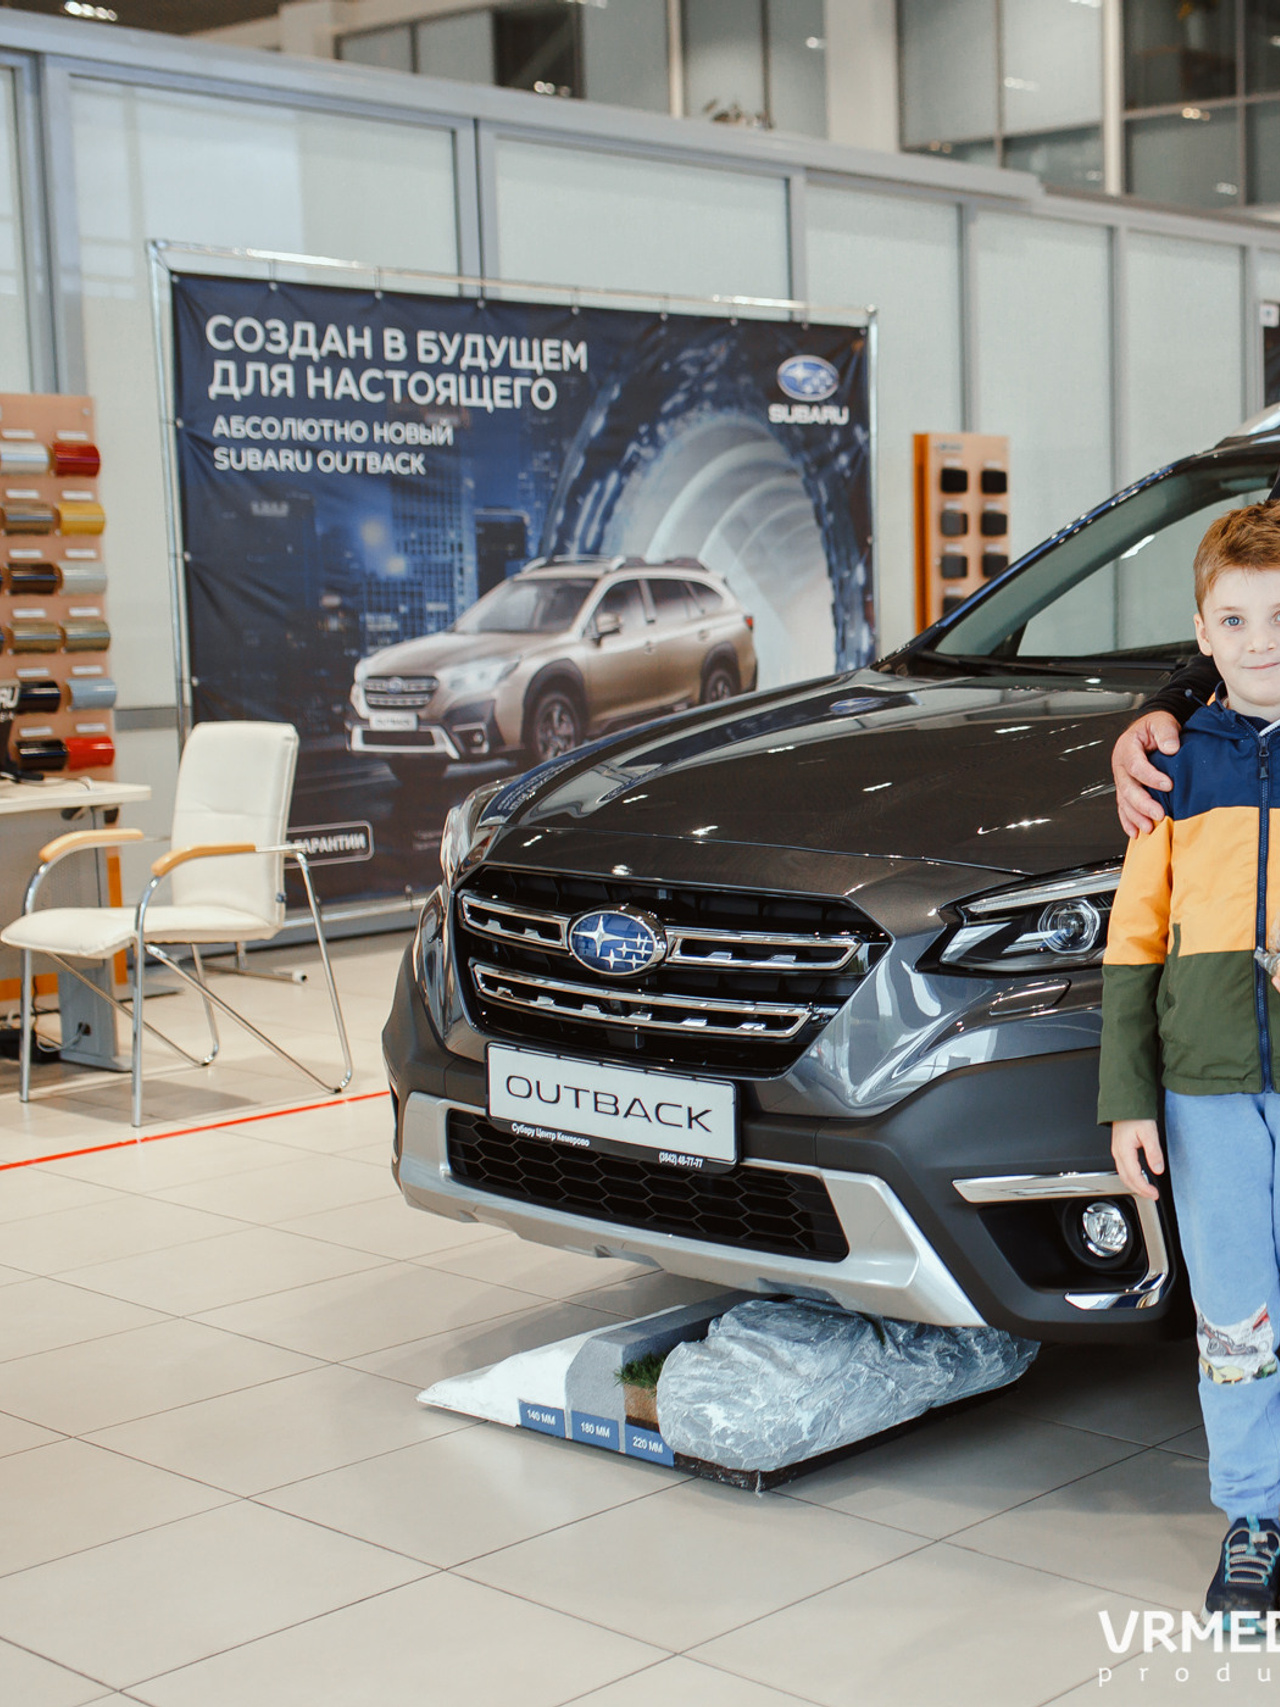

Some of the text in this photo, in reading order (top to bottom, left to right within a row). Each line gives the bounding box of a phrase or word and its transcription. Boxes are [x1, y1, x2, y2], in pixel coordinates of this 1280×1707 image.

[206, 314, 588, 373] СОЗДАН В БУДУЩЕМ
[208, 359, 558, 413] ДЛЯ НАСТОЯЩЕГО
[768, 403, 849, 425] SUBARU
[212, 414, 454, 446] АБСОЛЮТНО НОВЫЙ
[213, 447, 427, 476] SUBARU OUTBACK
[506, 1075, 713, 1133] OUTBACK
[511, 1123, 535, 1138] Субару
[536, 1127, 556, 1142] Центр
[526, 1409, 540, 1421] 140
[632, 1436, 648, 1450] 220
